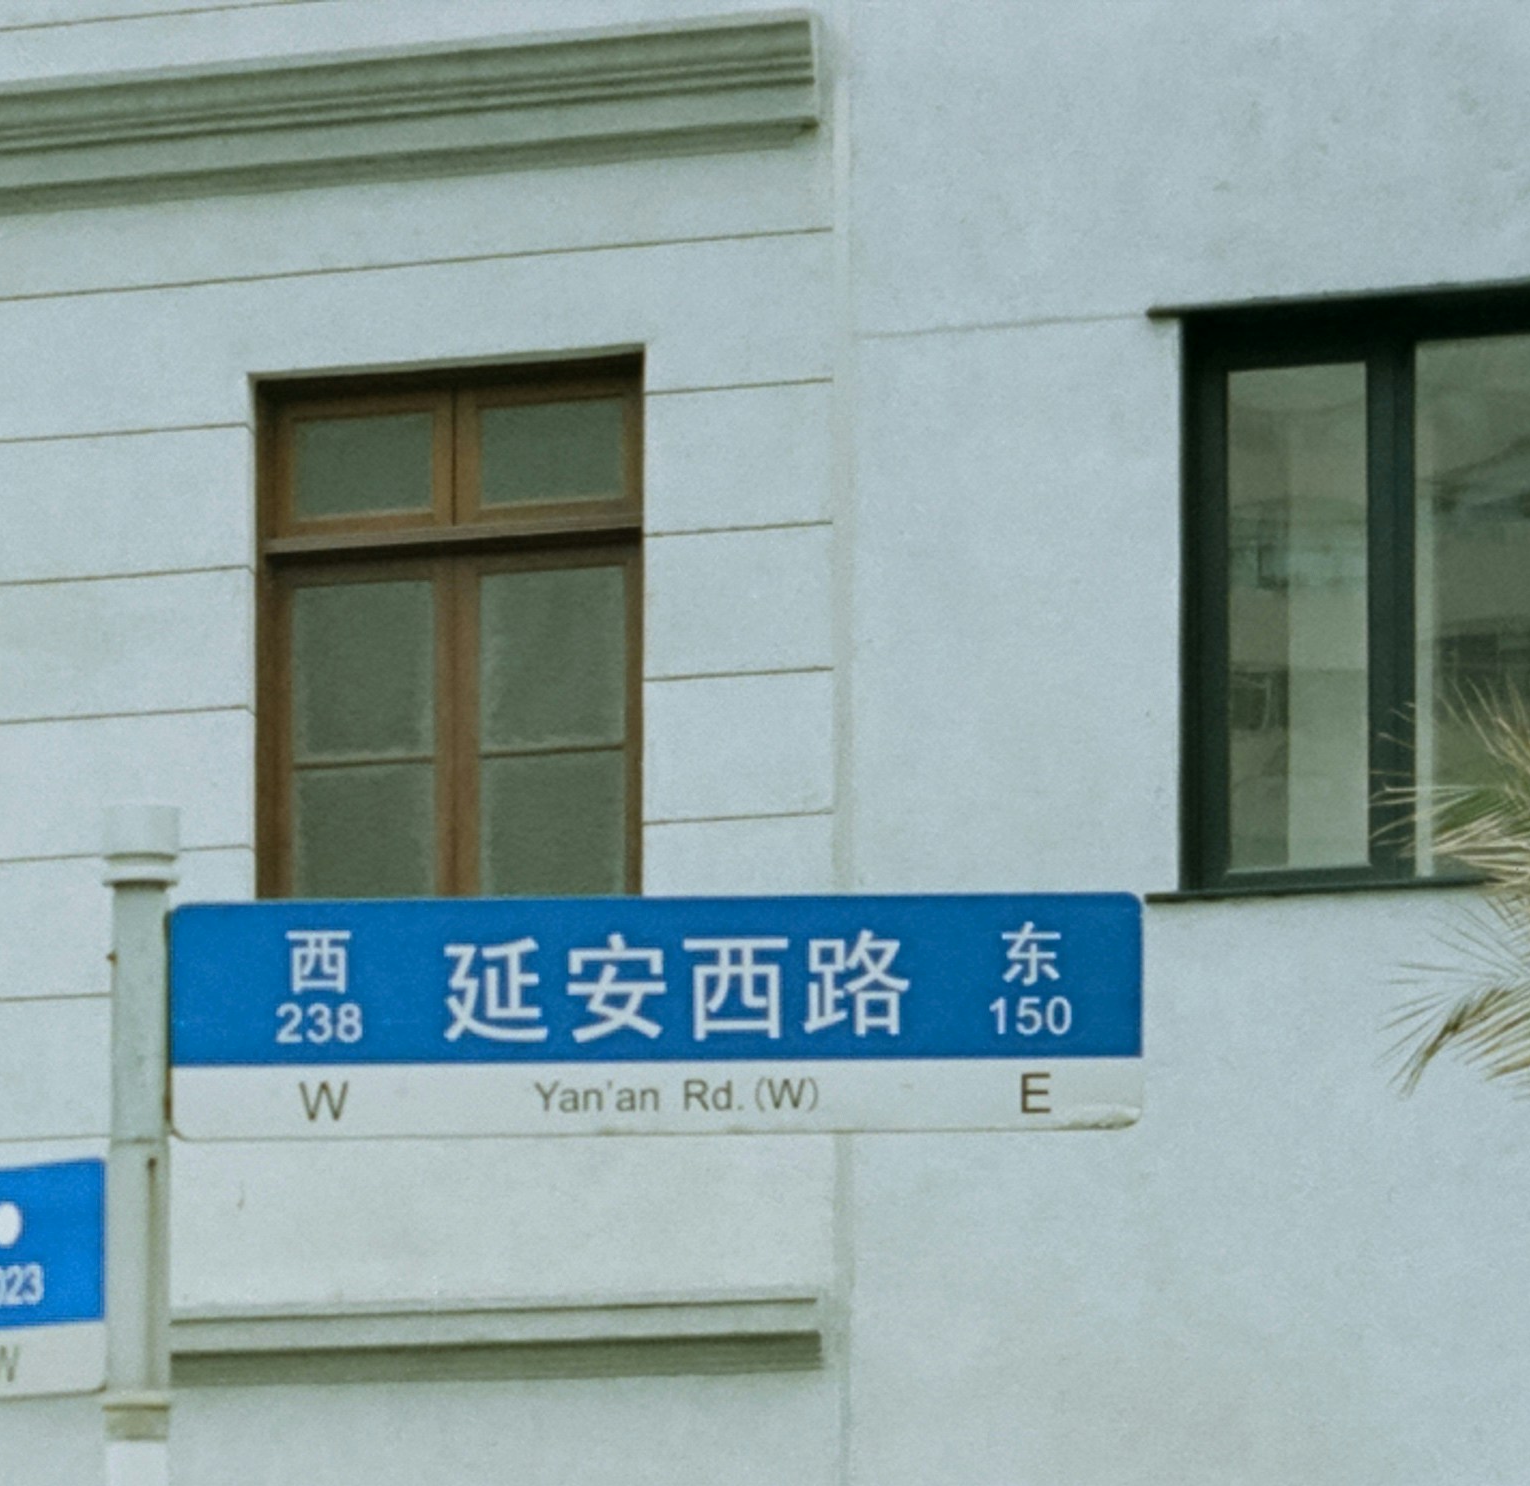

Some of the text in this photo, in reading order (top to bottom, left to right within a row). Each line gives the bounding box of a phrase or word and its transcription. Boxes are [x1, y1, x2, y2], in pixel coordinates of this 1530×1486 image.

[285, 929, 352, 994] 西
[1000, 920, 1062, 987] 东
[443, 929, 911, 1044] 延安西路
[274, 1002, 363, 1044] 238
[988, 996, 1073, 1036] 150
[299, 1080, 348, 1122] W
[534, 1081, 660, 1113] Yan'an
[1020, 1072, 1052, 1114] E
